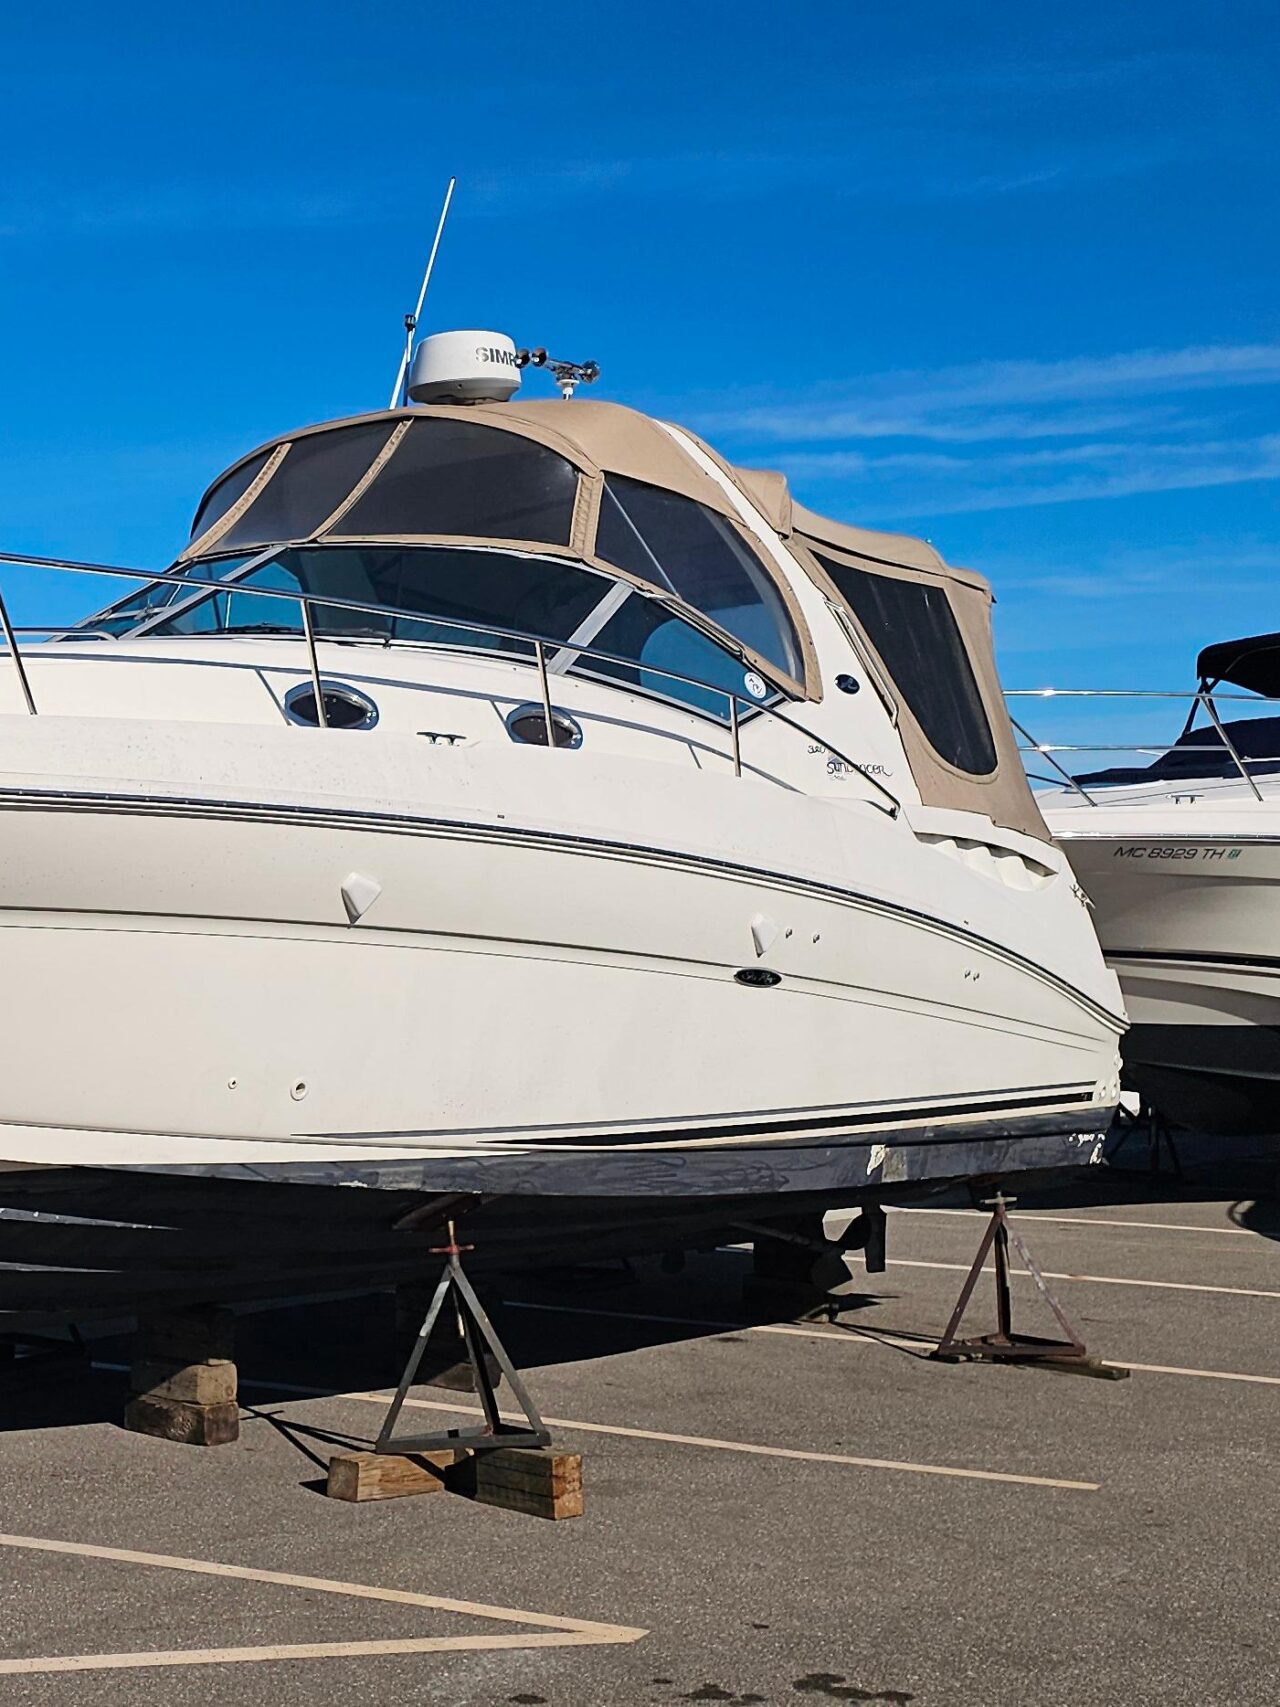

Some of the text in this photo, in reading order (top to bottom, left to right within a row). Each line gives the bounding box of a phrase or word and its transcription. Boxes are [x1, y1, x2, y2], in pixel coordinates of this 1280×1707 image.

[1113, 846, 1145, 859] MC
[1147, 847, 1198, 860] 8929
[1201, 848, 1227, 860] TH
